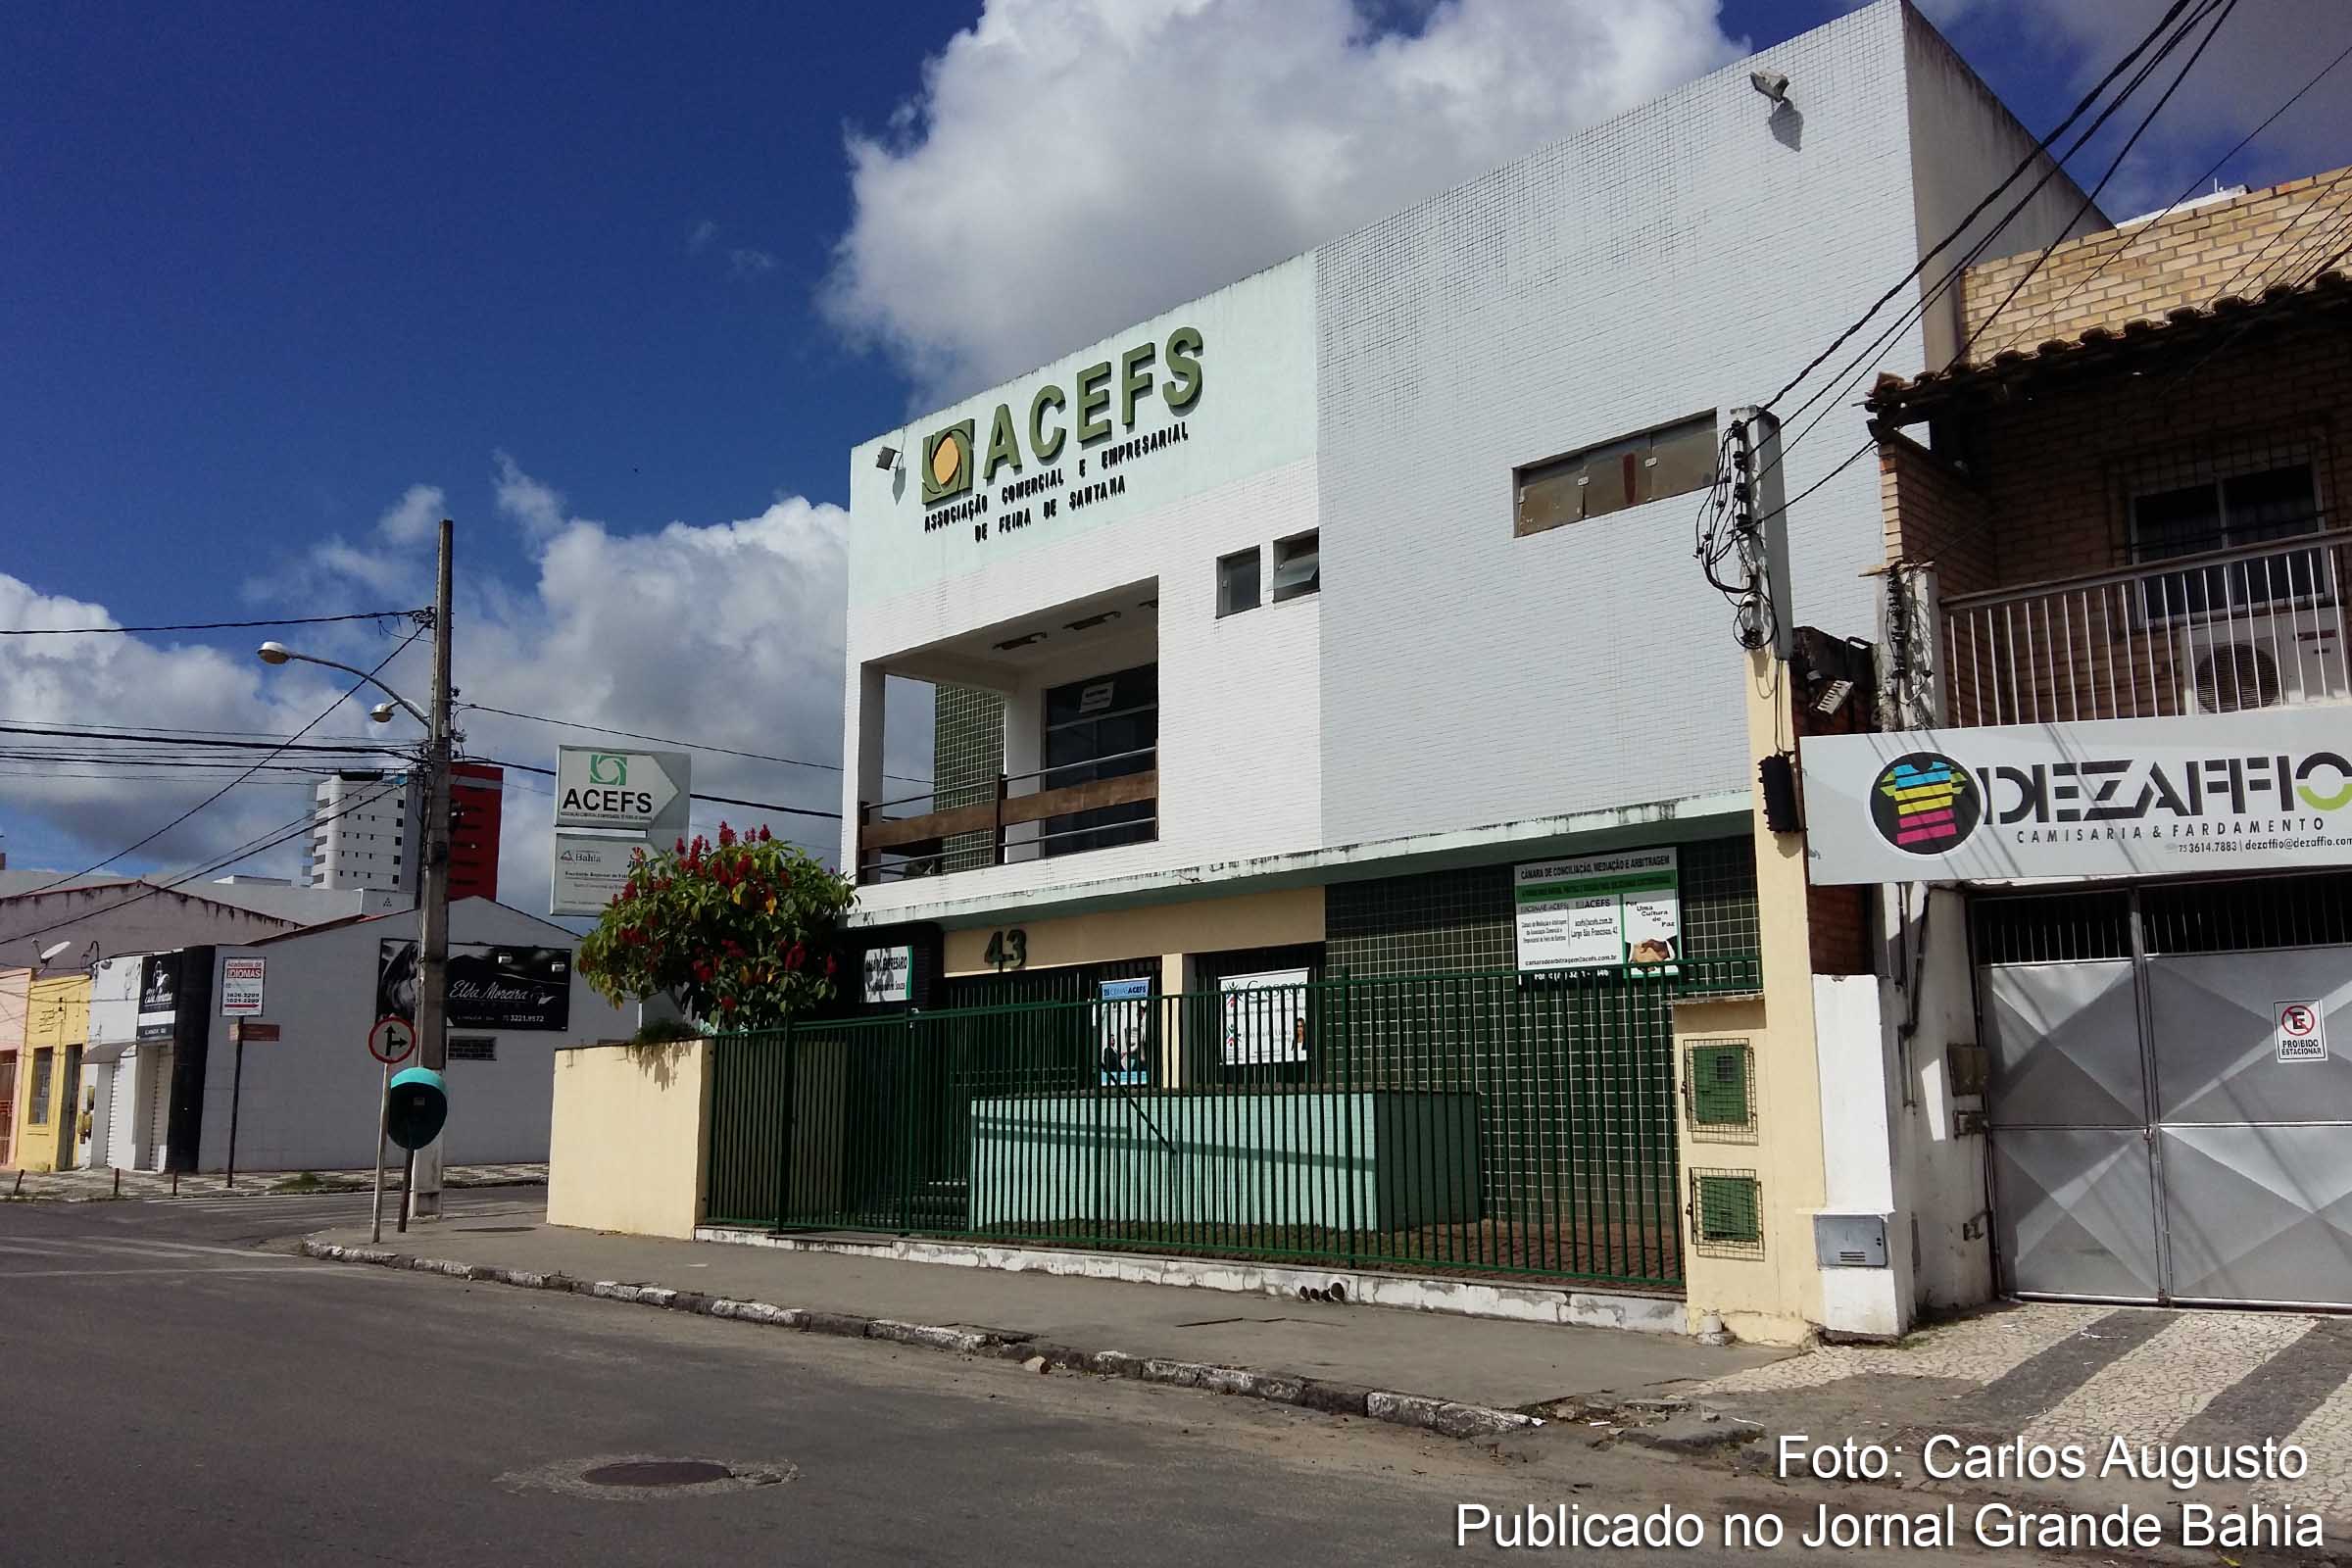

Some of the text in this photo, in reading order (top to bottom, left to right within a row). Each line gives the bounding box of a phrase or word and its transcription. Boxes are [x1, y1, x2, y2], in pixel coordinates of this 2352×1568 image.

[982, 326, 1204, 481] ACEFS
[924, 421, 1189, 533] ASSOCIAÇÃO COMERCIAL E EMPRESARIAL
[974, 474, 1126, 543] DE FEIRA DE SANTANA
[1976, 751, 2352, 826] DEZAFFIO
[562, 788, 653, 813] ACEFS
[2017, 816, 2324, 844] CAMISARIA & FARDAMENTO
[575, 854, 601, 862] Bahia
[2188, 841, 2237, 854] 3614.7883
[1584, 898, 1611, 909] ACEFS
[984, 929, 1027, 972] 43
[227, 968, 261, 978] IDIOMAS
[449, 979, 529, 1001] Elda Moreira
[1128, 985, 1147, 994] ACEFS
[2282, 1039, 2319, 1049] PROIBIDO
